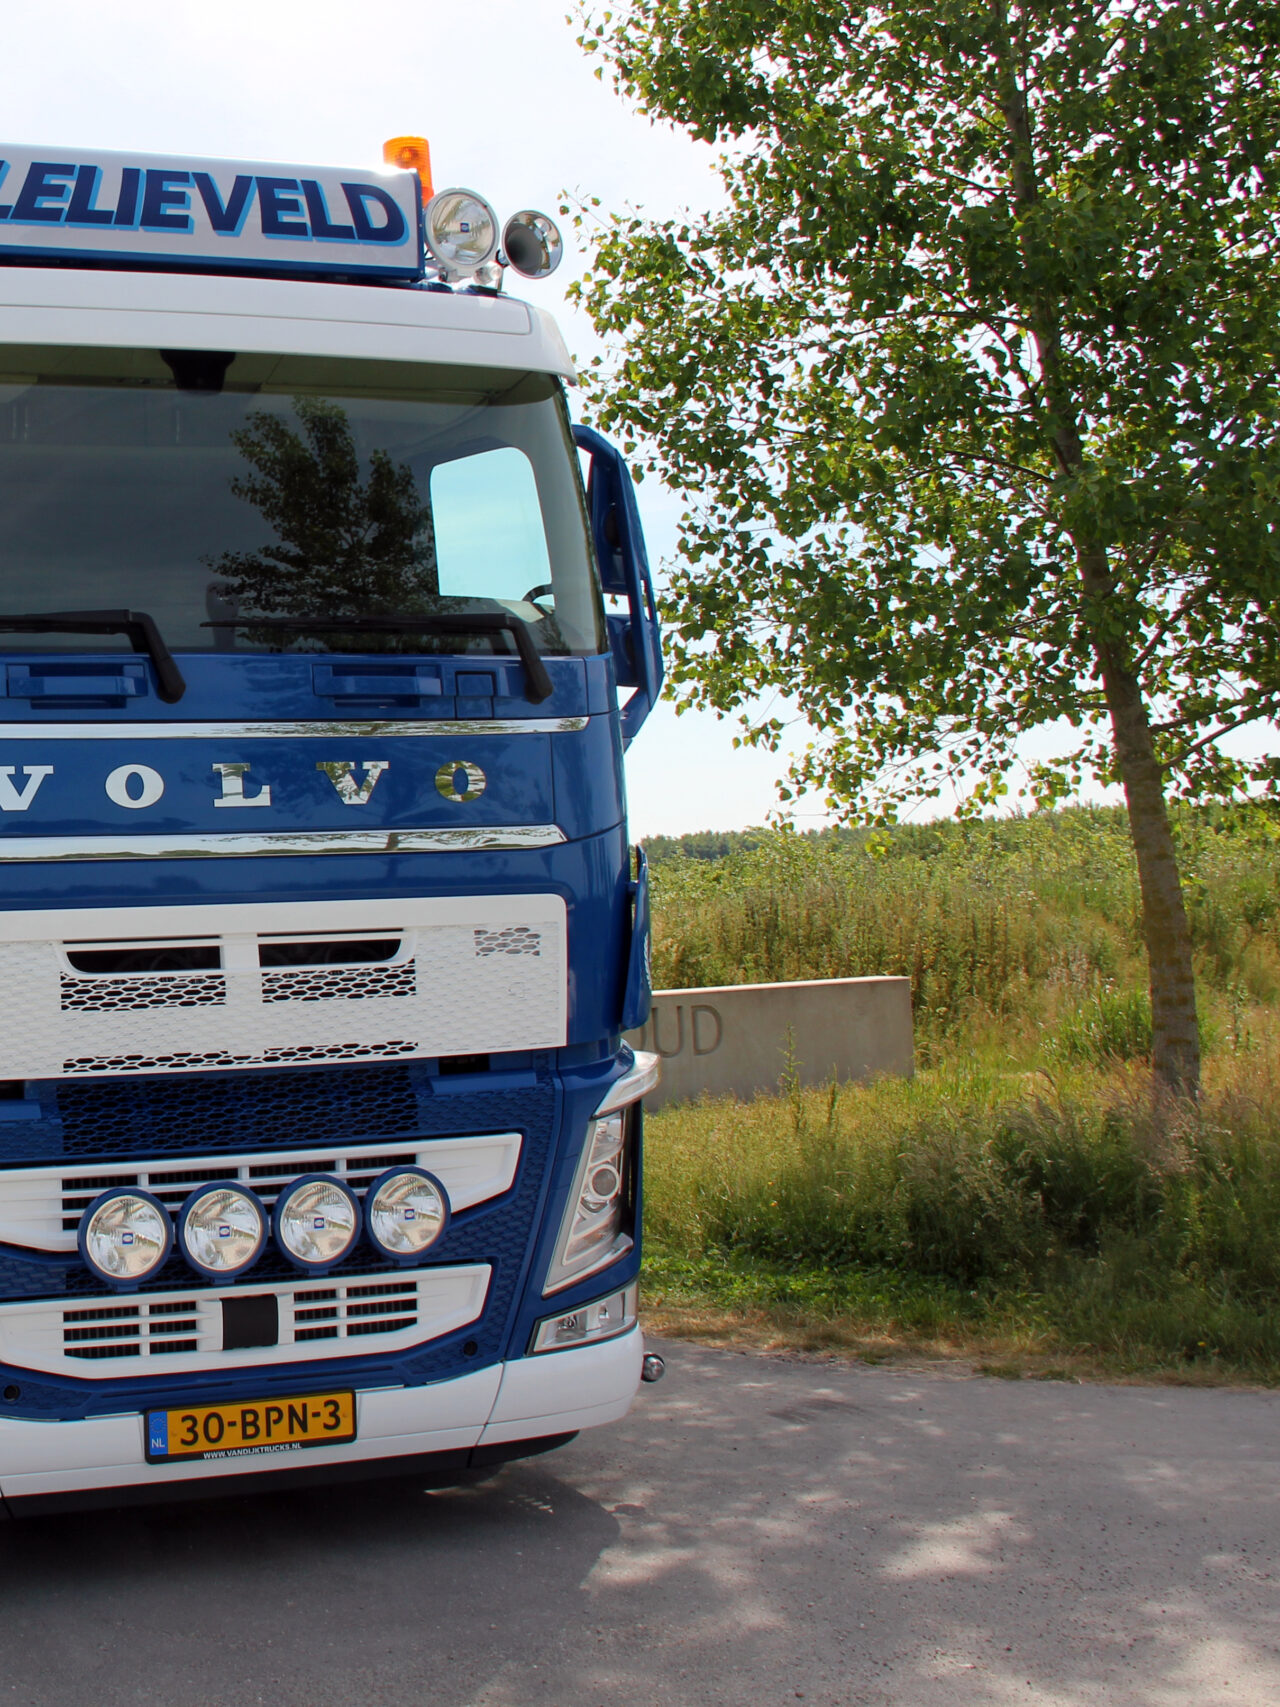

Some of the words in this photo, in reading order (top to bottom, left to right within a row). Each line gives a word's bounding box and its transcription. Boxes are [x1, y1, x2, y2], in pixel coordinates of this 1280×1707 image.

[639, 1005, 722, 1058] UD
[180, 1399, 341, 1446] 30-BPN-3
[151, 1439, 165, 1448] NL
[203, 1443, 302, 1459] WWW.VANDIJKTRUCKS.NL
